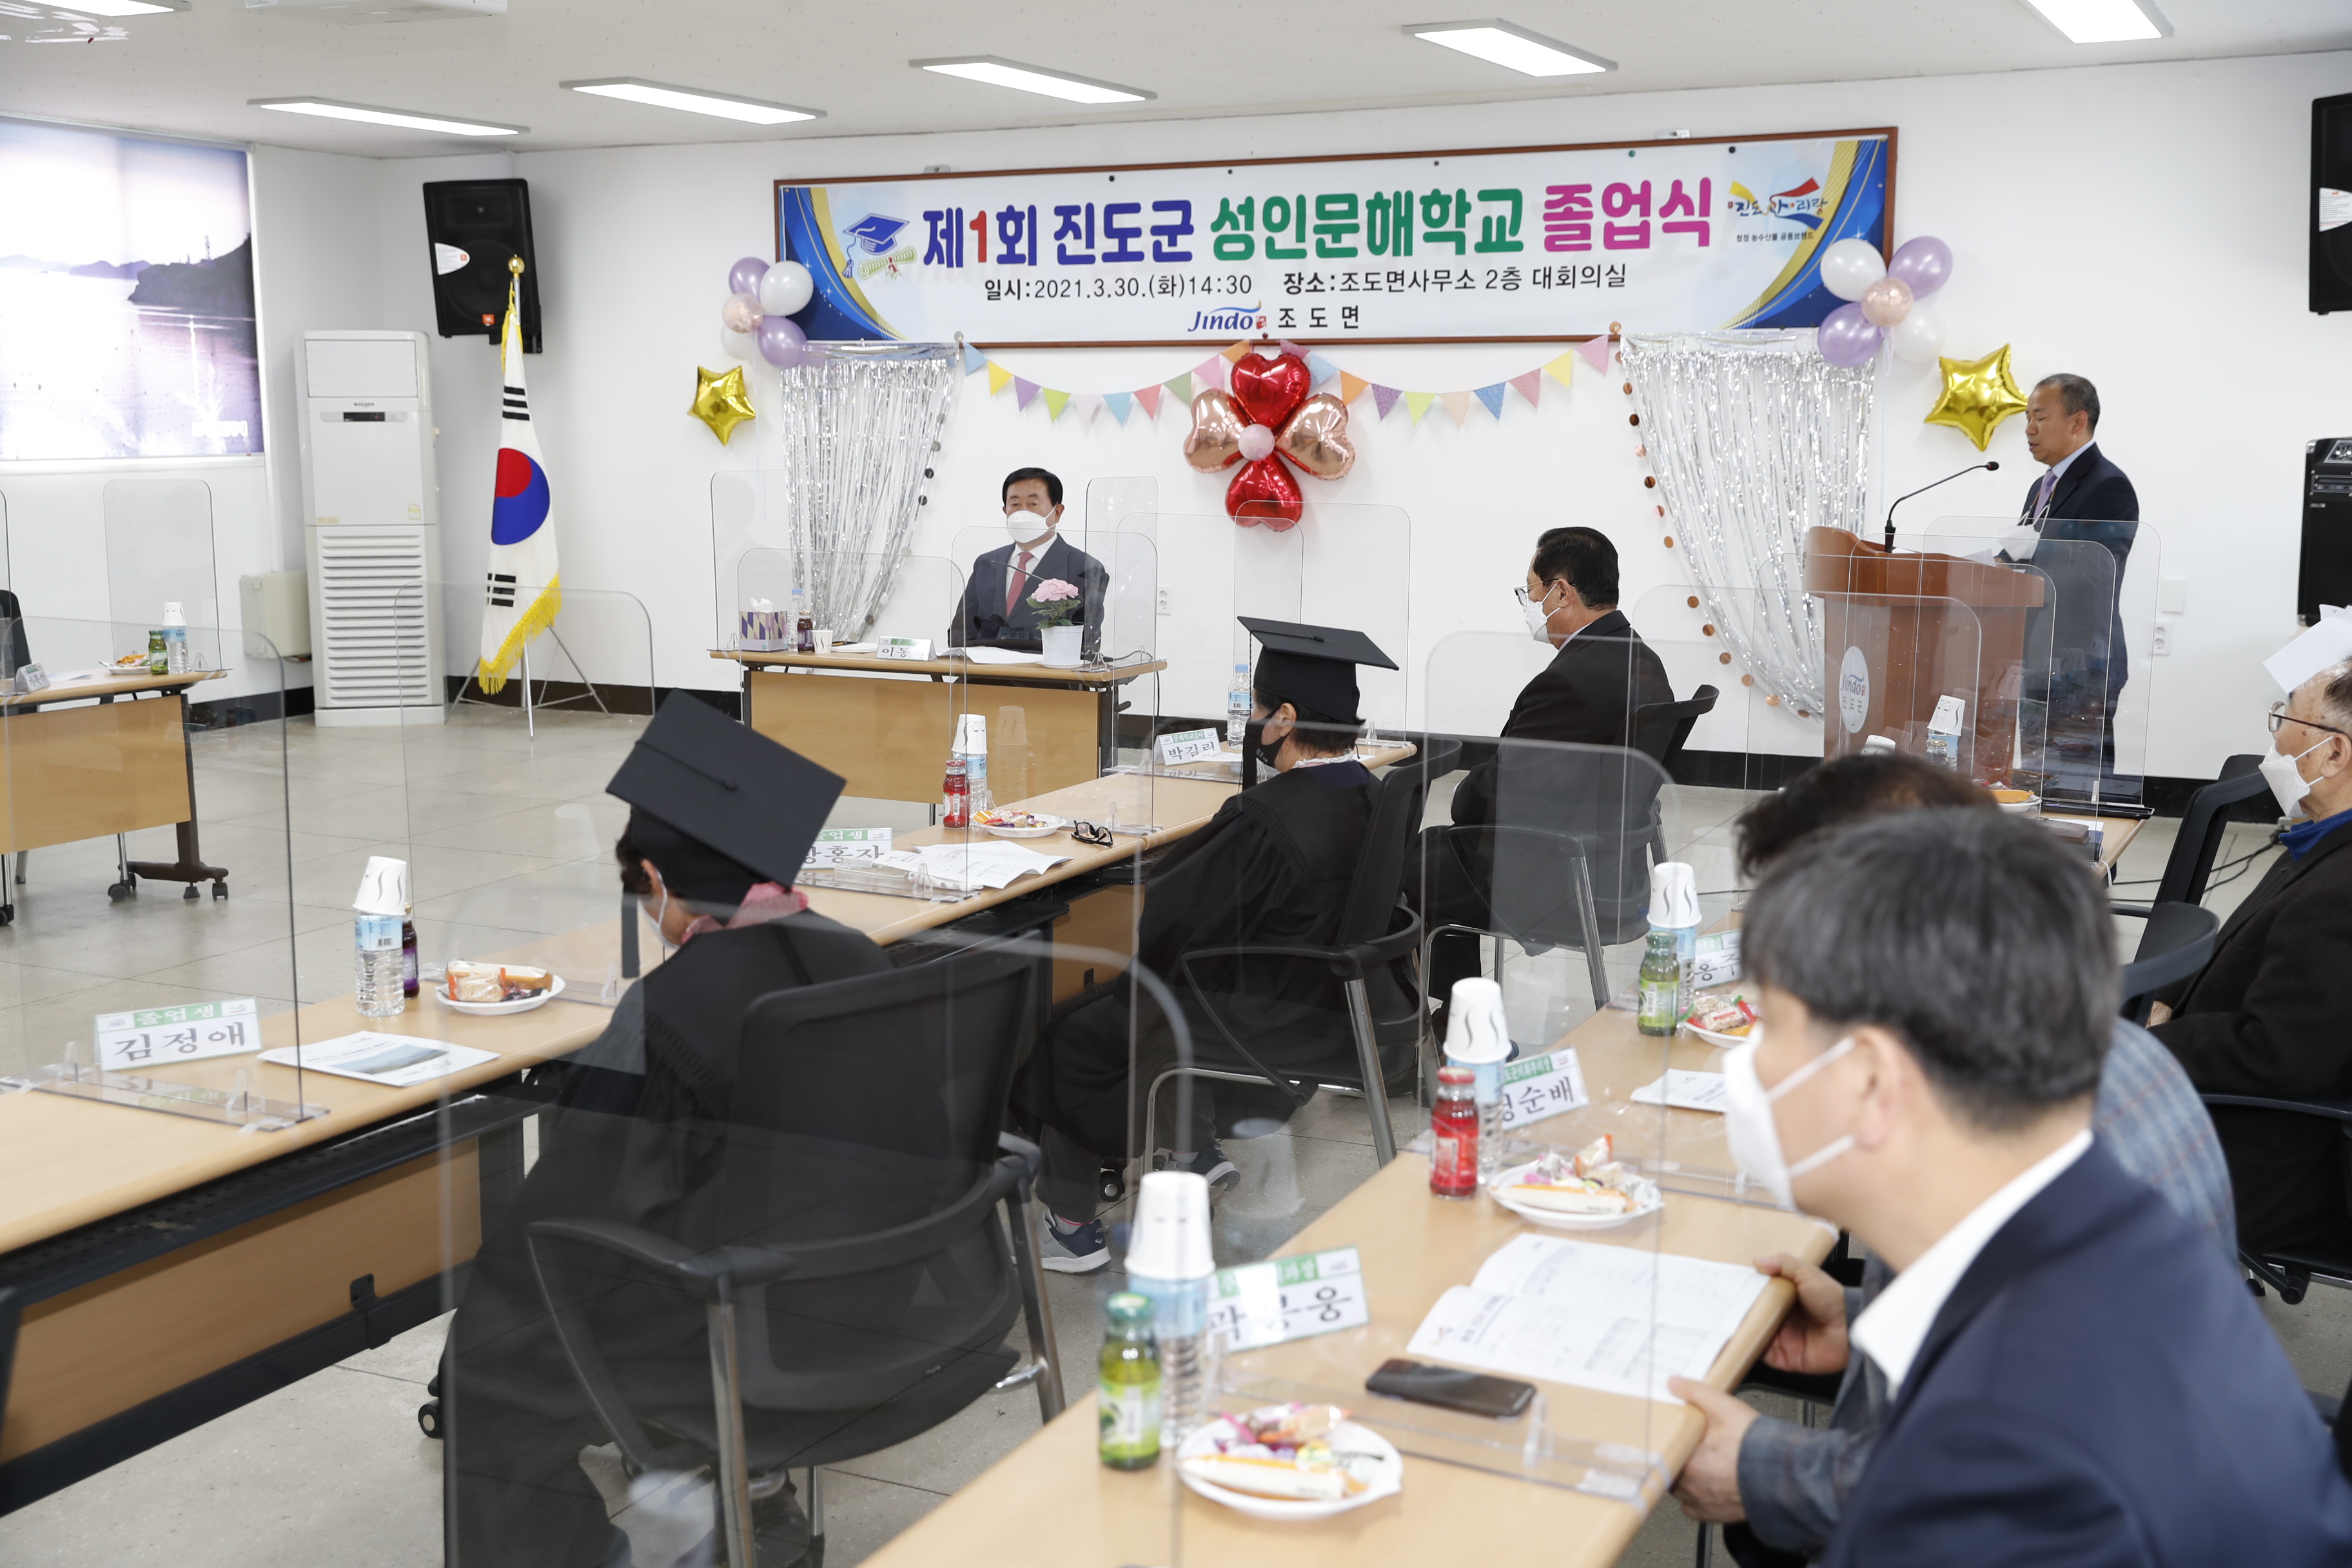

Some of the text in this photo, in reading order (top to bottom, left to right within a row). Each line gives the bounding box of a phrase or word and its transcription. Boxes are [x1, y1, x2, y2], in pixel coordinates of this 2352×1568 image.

[923, 176, 1712, 268] 제1회 진도군 성인문해학교 졸업식
[1484, 266, 1523, 291] 2층
[1532, 262, 1627, 289] 대회의실
[1188, 311, 1253, 332] Jindo
[1173, 731, 1205, 742] 문해학교강사
[137, 1004, 215, 1026] 졸업생
[113, 1021, 246, 1062] 김정애
